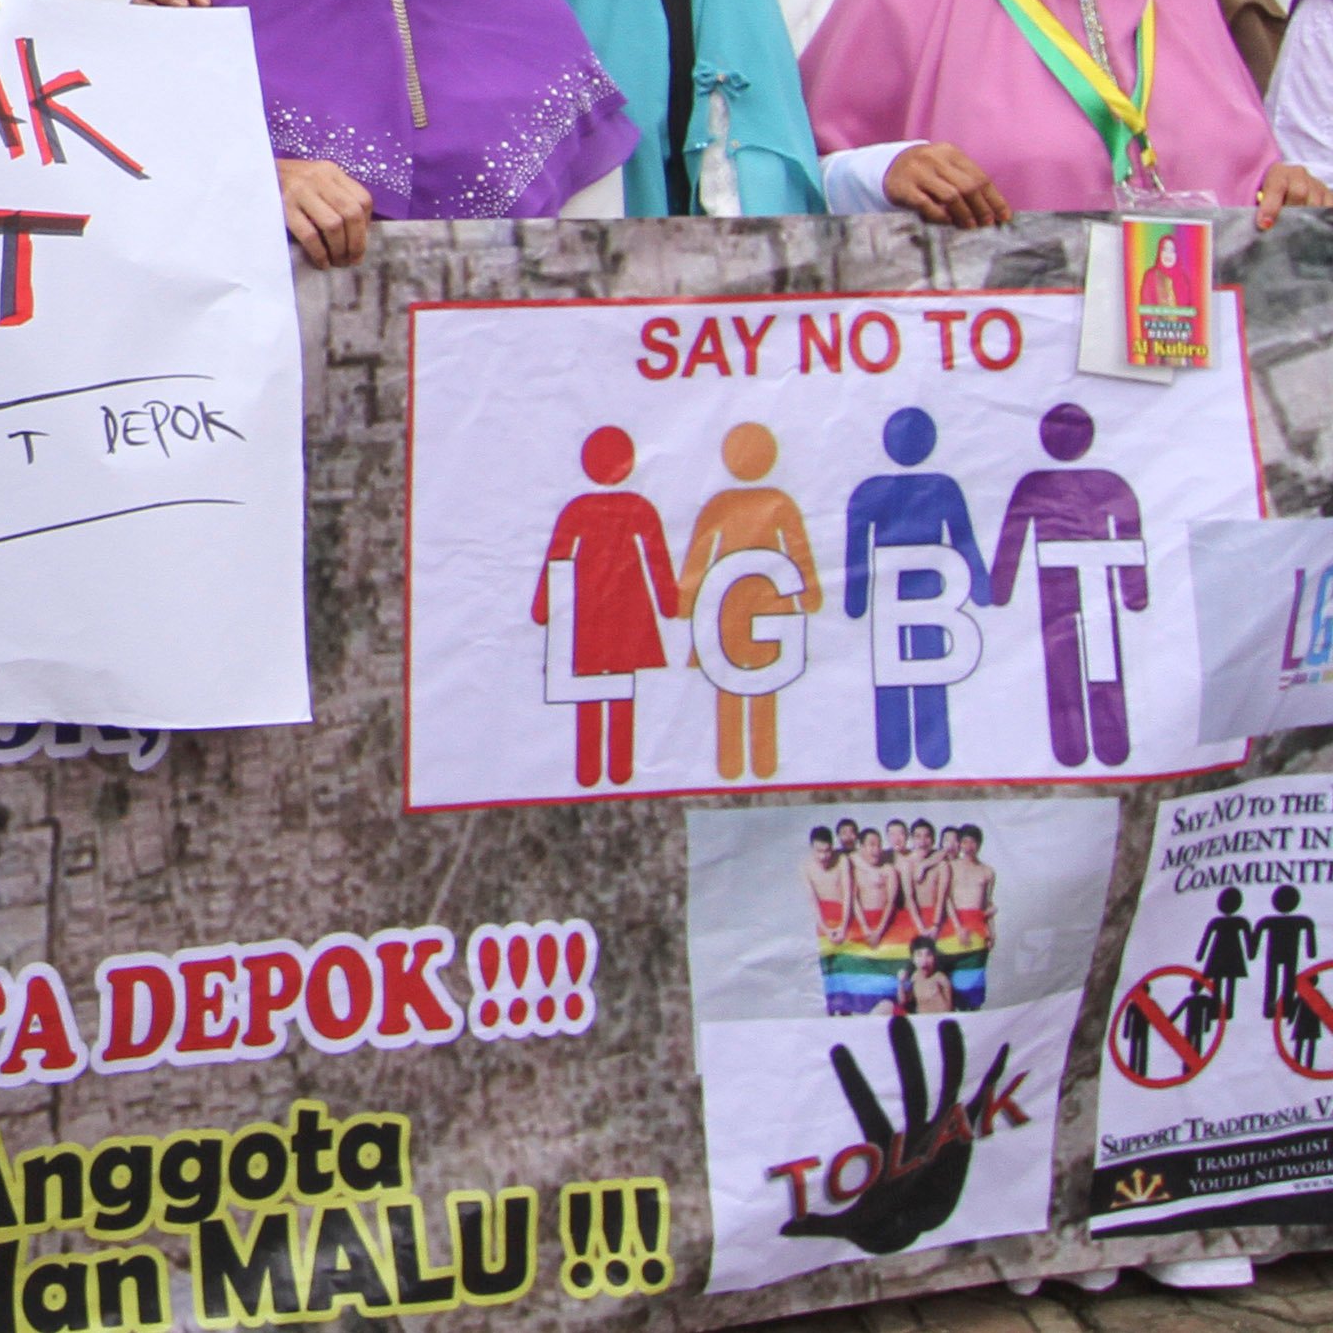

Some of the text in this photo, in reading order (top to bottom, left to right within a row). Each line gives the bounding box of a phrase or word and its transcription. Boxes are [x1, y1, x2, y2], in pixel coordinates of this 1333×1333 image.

[636, 308, 1023, 381] SAY NO TO
[102, 399, 246, 460] DEPOK
[545, 539, 1146, 704] LGBT
[1209, 793, 1245, 828] NO
[1281, 792, 1327, 815] THE
[1161, 826, 1294, 871] MOVEMENT
[767, 1070, 1032, 1220] TOLAK
[197, 1197, 532, 1323] MALU
